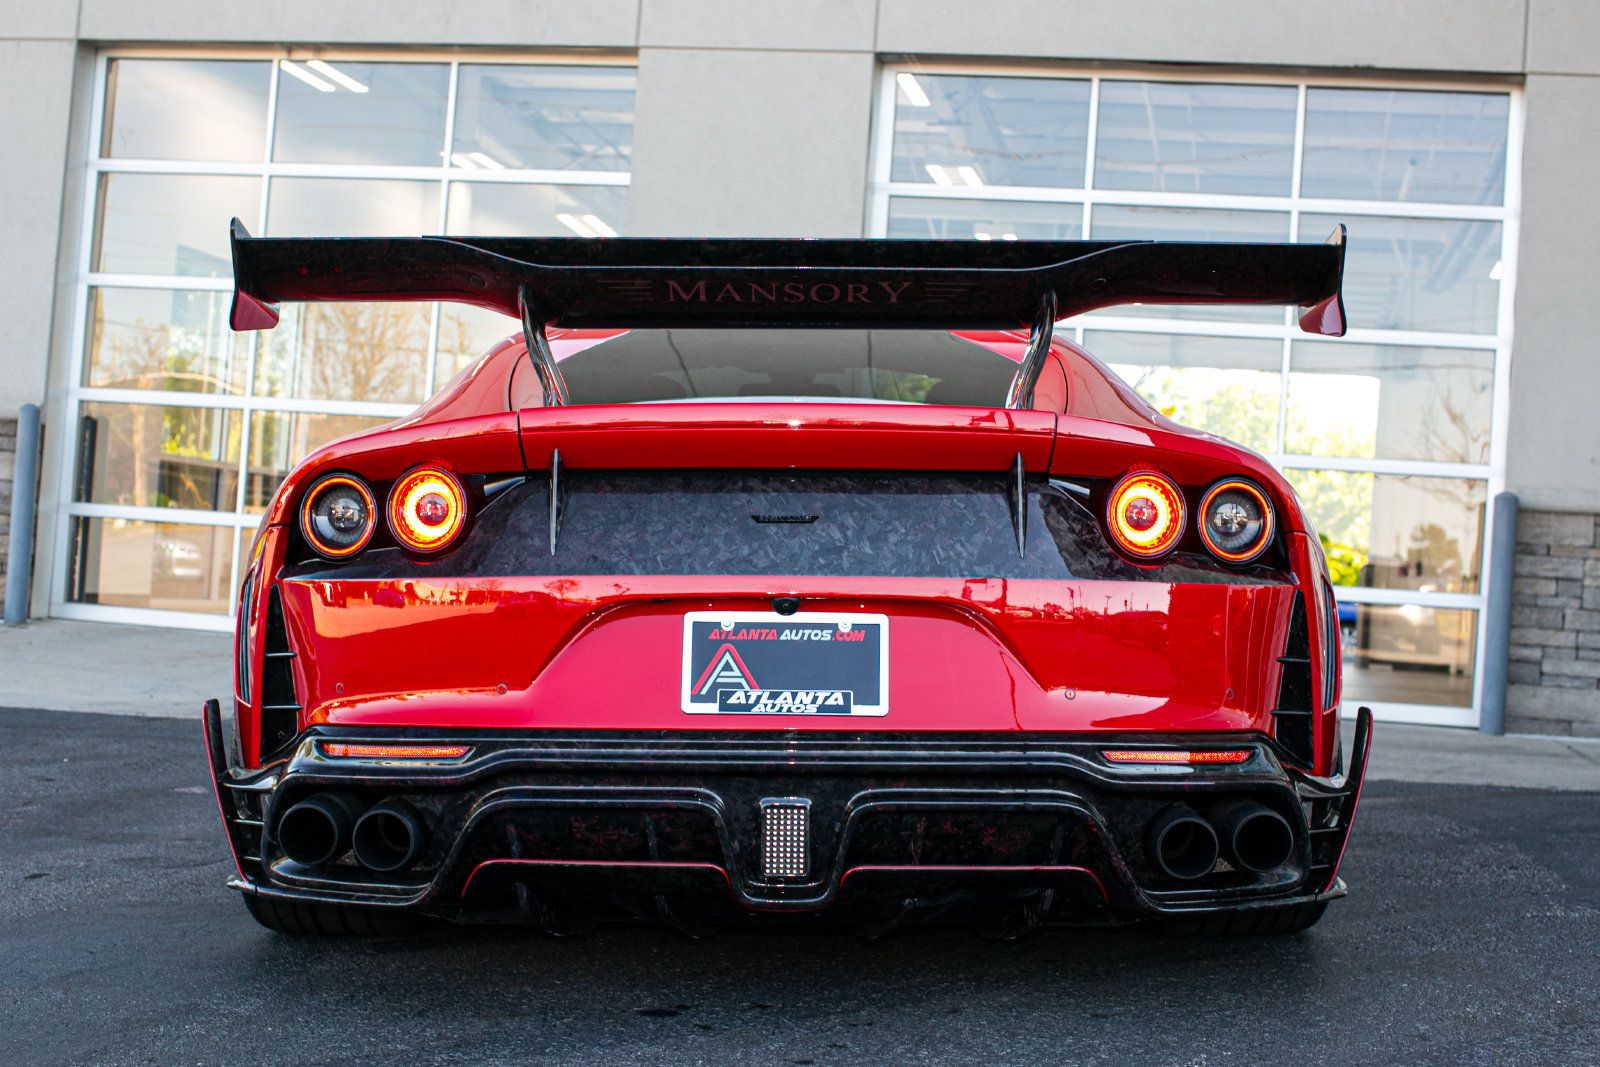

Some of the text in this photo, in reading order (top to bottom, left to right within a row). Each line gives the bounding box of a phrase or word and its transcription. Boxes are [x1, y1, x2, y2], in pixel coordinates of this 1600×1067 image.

[665, 279, 912, 304] MANSORY
[708, 629, 777, 640] ATLANTA
[727, 690, 845, 705] ATLANTA
[751, 703, 818, 713] AUTOS
